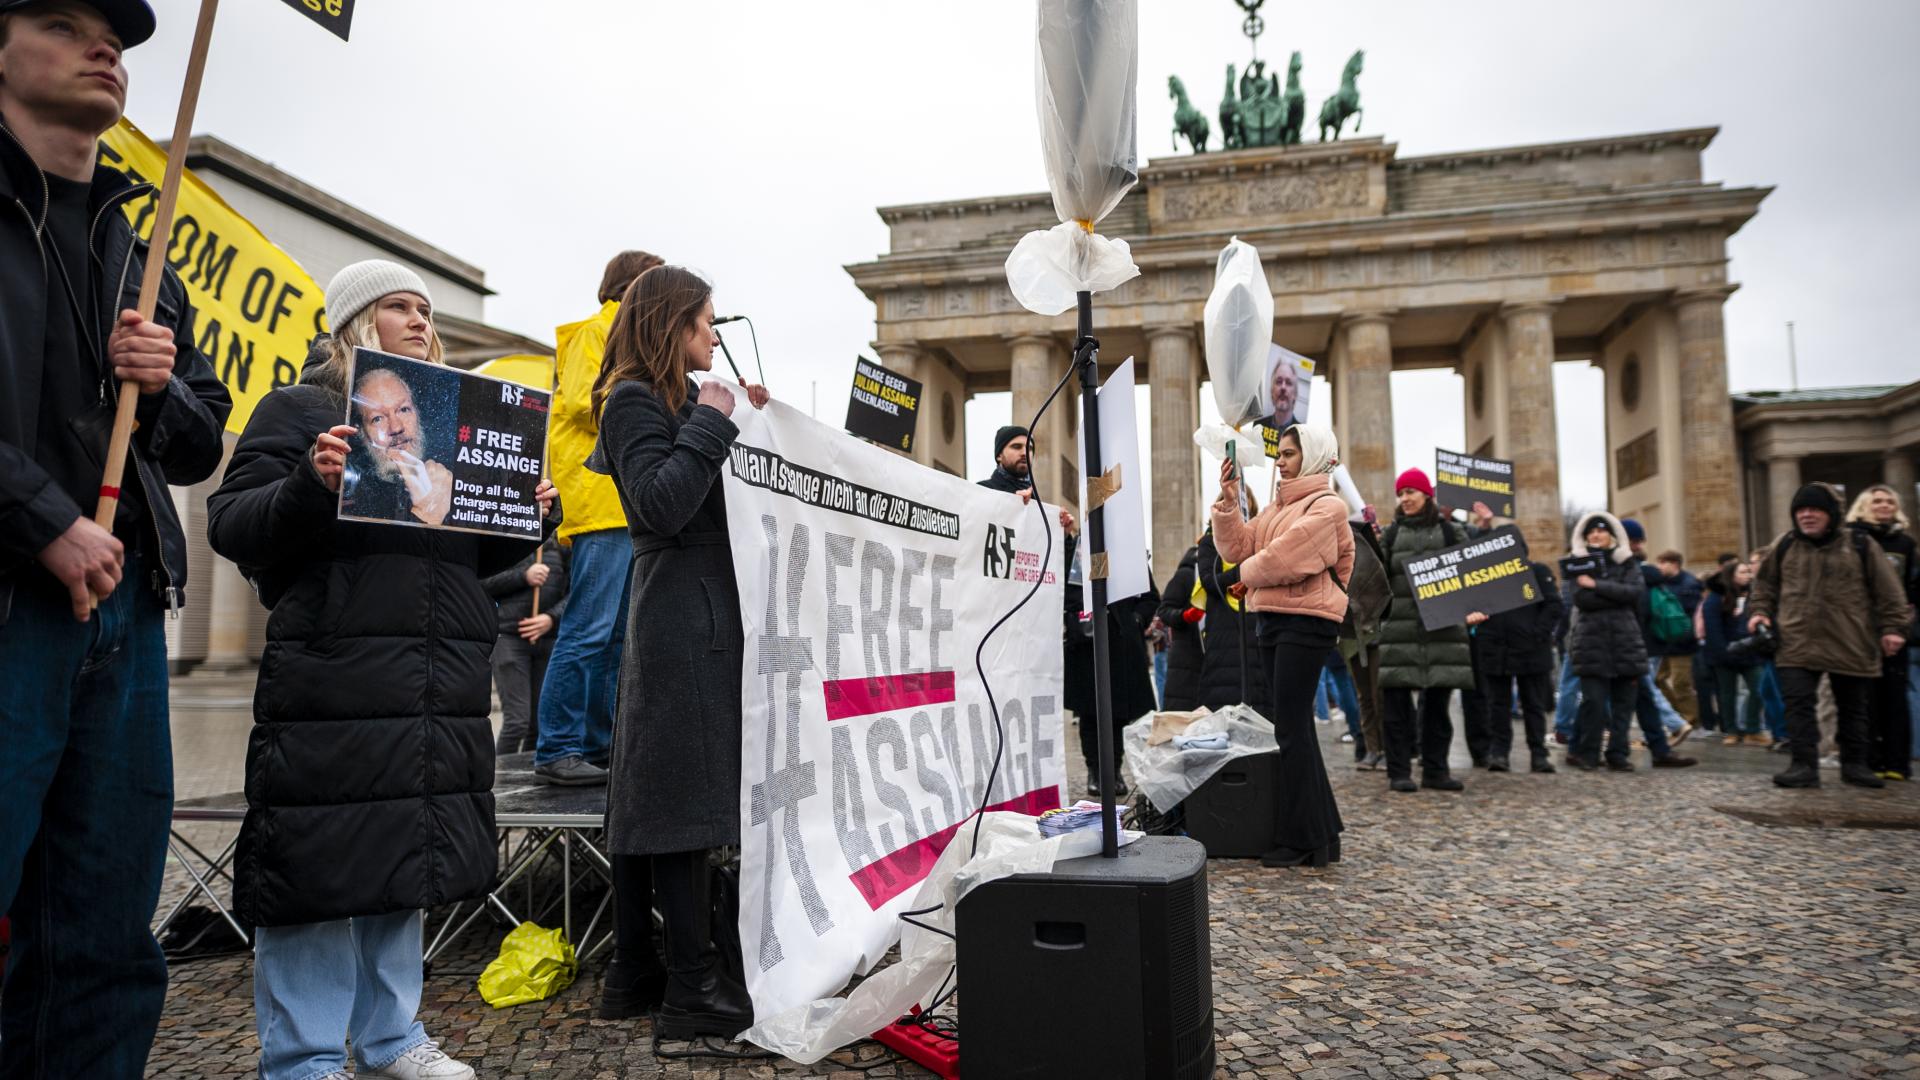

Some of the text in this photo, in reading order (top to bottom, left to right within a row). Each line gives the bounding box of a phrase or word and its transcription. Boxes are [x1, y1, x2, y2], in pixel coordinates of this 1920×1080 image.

[240, 267, 303, 334] OF
[501, 383, 525, 406] RSF
[855, 374, 917, 411] JULIAN ASSANGE
[884, 373, 908, 393] GEGEN
[458, 425, 522, 452] # FREE
[457, 446, 540, 475] ASSANGE
[1458, 456, 1474, 469] THE
[1474, 459, 1511, 474] CHARGES
[455, 479, 520, 499] Drop all the
[1438, 470, 1468, 487] JULIAN
[453, 495, 535, 515] charges against
[821, 478, 854, 511] nicht
[855, 490, 868, 516] an
[869, 492, 888, 520] die
[887, 498, 910, 526] USA
[909, 506, 958, 538] ausliefern!
[452, 509, 540, 531] Julian Assange
[1016, 550, 1040, 568] REPORTER
[1408, 534, 1516, 575] DROP THE CHARGES
[1014, 567, 1056, 584] OHNE GREZEN
[1413, 564, 1459, 587] AGAINST
[1416, 558, 1529, 600] JULIAN ASSANGE.
[824, 531, 957, 702] FREE
[831, 696, 1056, 898] ASSANGE
